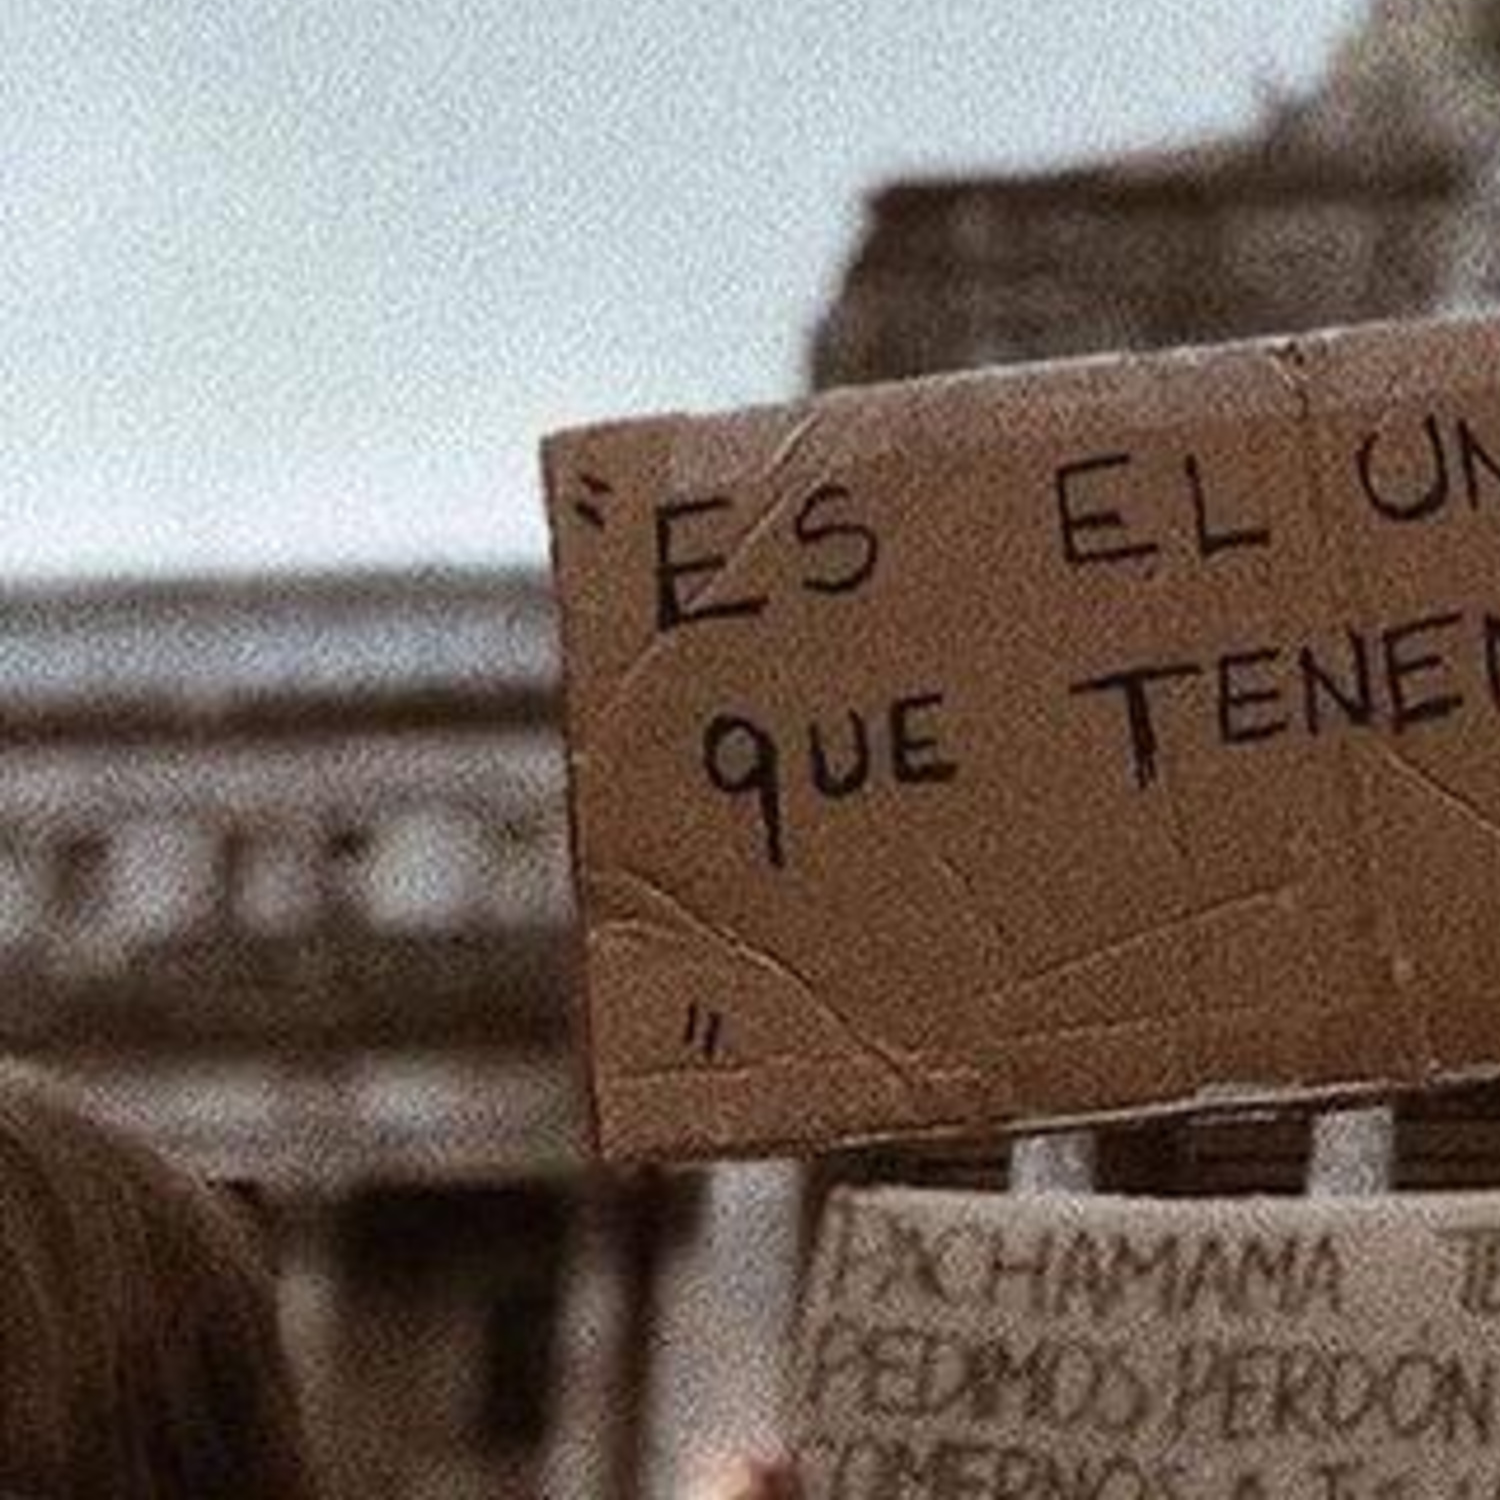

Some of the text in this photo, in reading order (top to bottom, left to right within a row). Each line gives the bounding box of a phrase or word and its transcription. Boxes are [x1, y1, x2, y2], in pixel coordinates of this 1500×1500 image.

[654, 483, 879, 631] ES
[1055, 454, 1271, 564] EL
[832, 1202, 1343, 1315] PACHAMAMA
